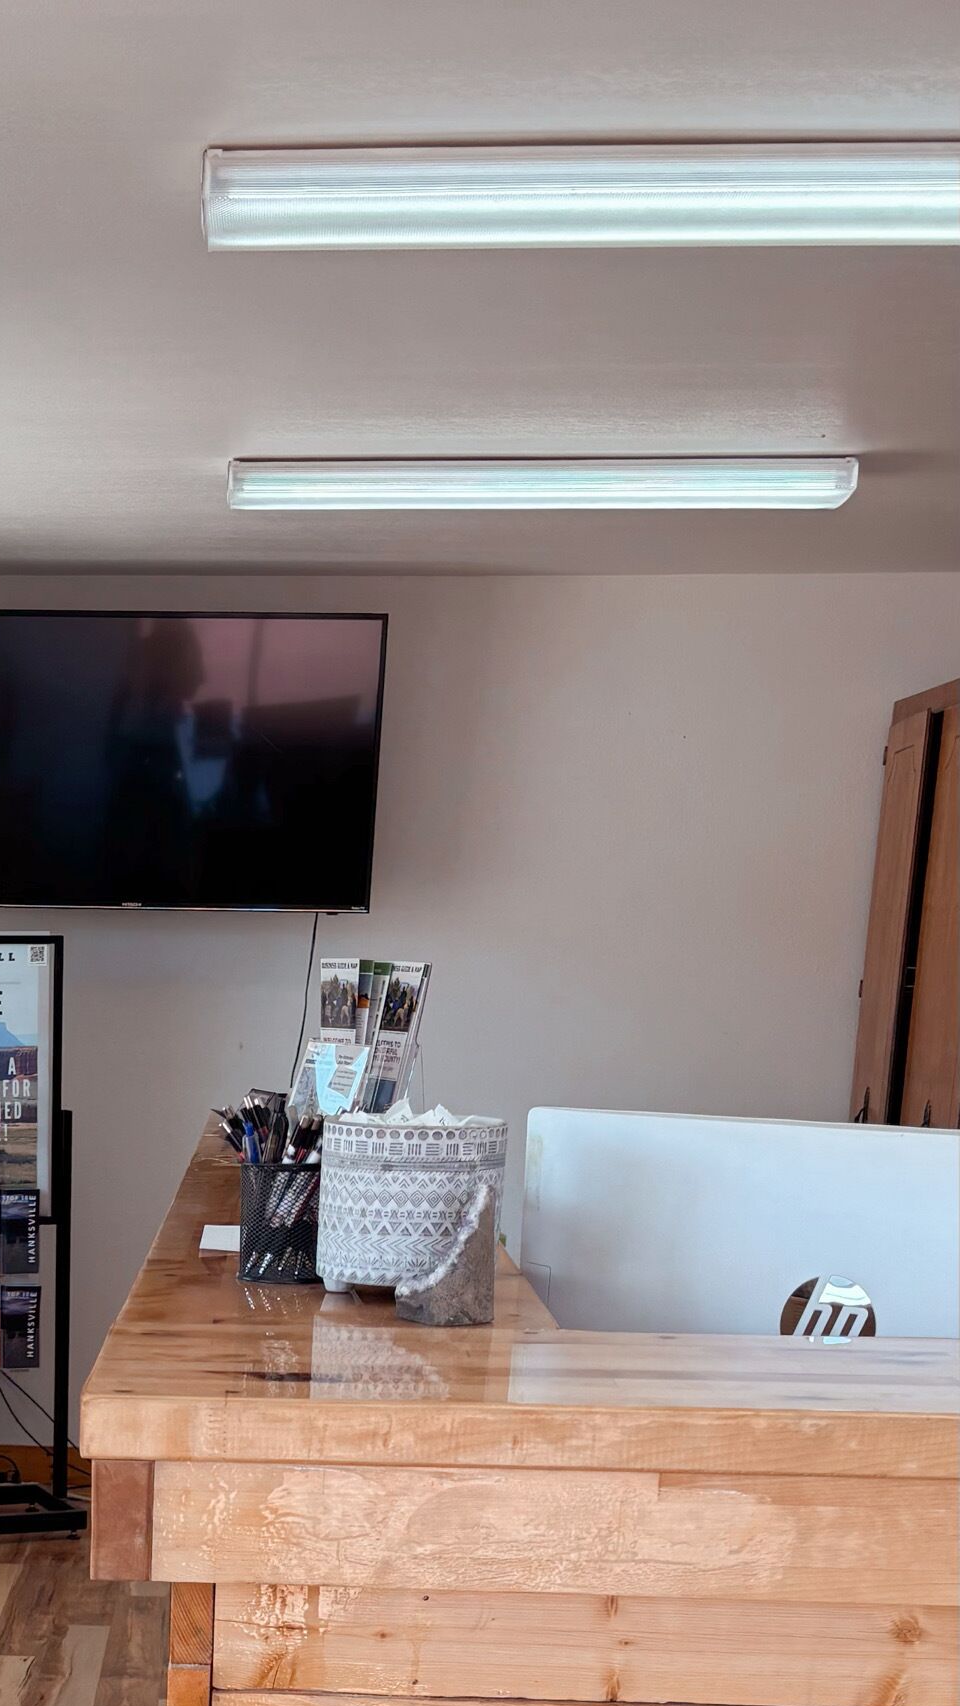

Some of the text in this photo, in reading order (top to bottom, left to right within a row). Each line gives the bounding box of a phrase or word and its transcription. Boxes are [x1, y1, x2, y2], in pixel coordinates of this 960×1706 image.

[8, 1057, 16, 1076] A
[2, 1079, 31, 1097] FOR
[27, 1195, 36, 1263] HANKSVILLE
[26, 1292, 38, 1358] HANKSVILLE
